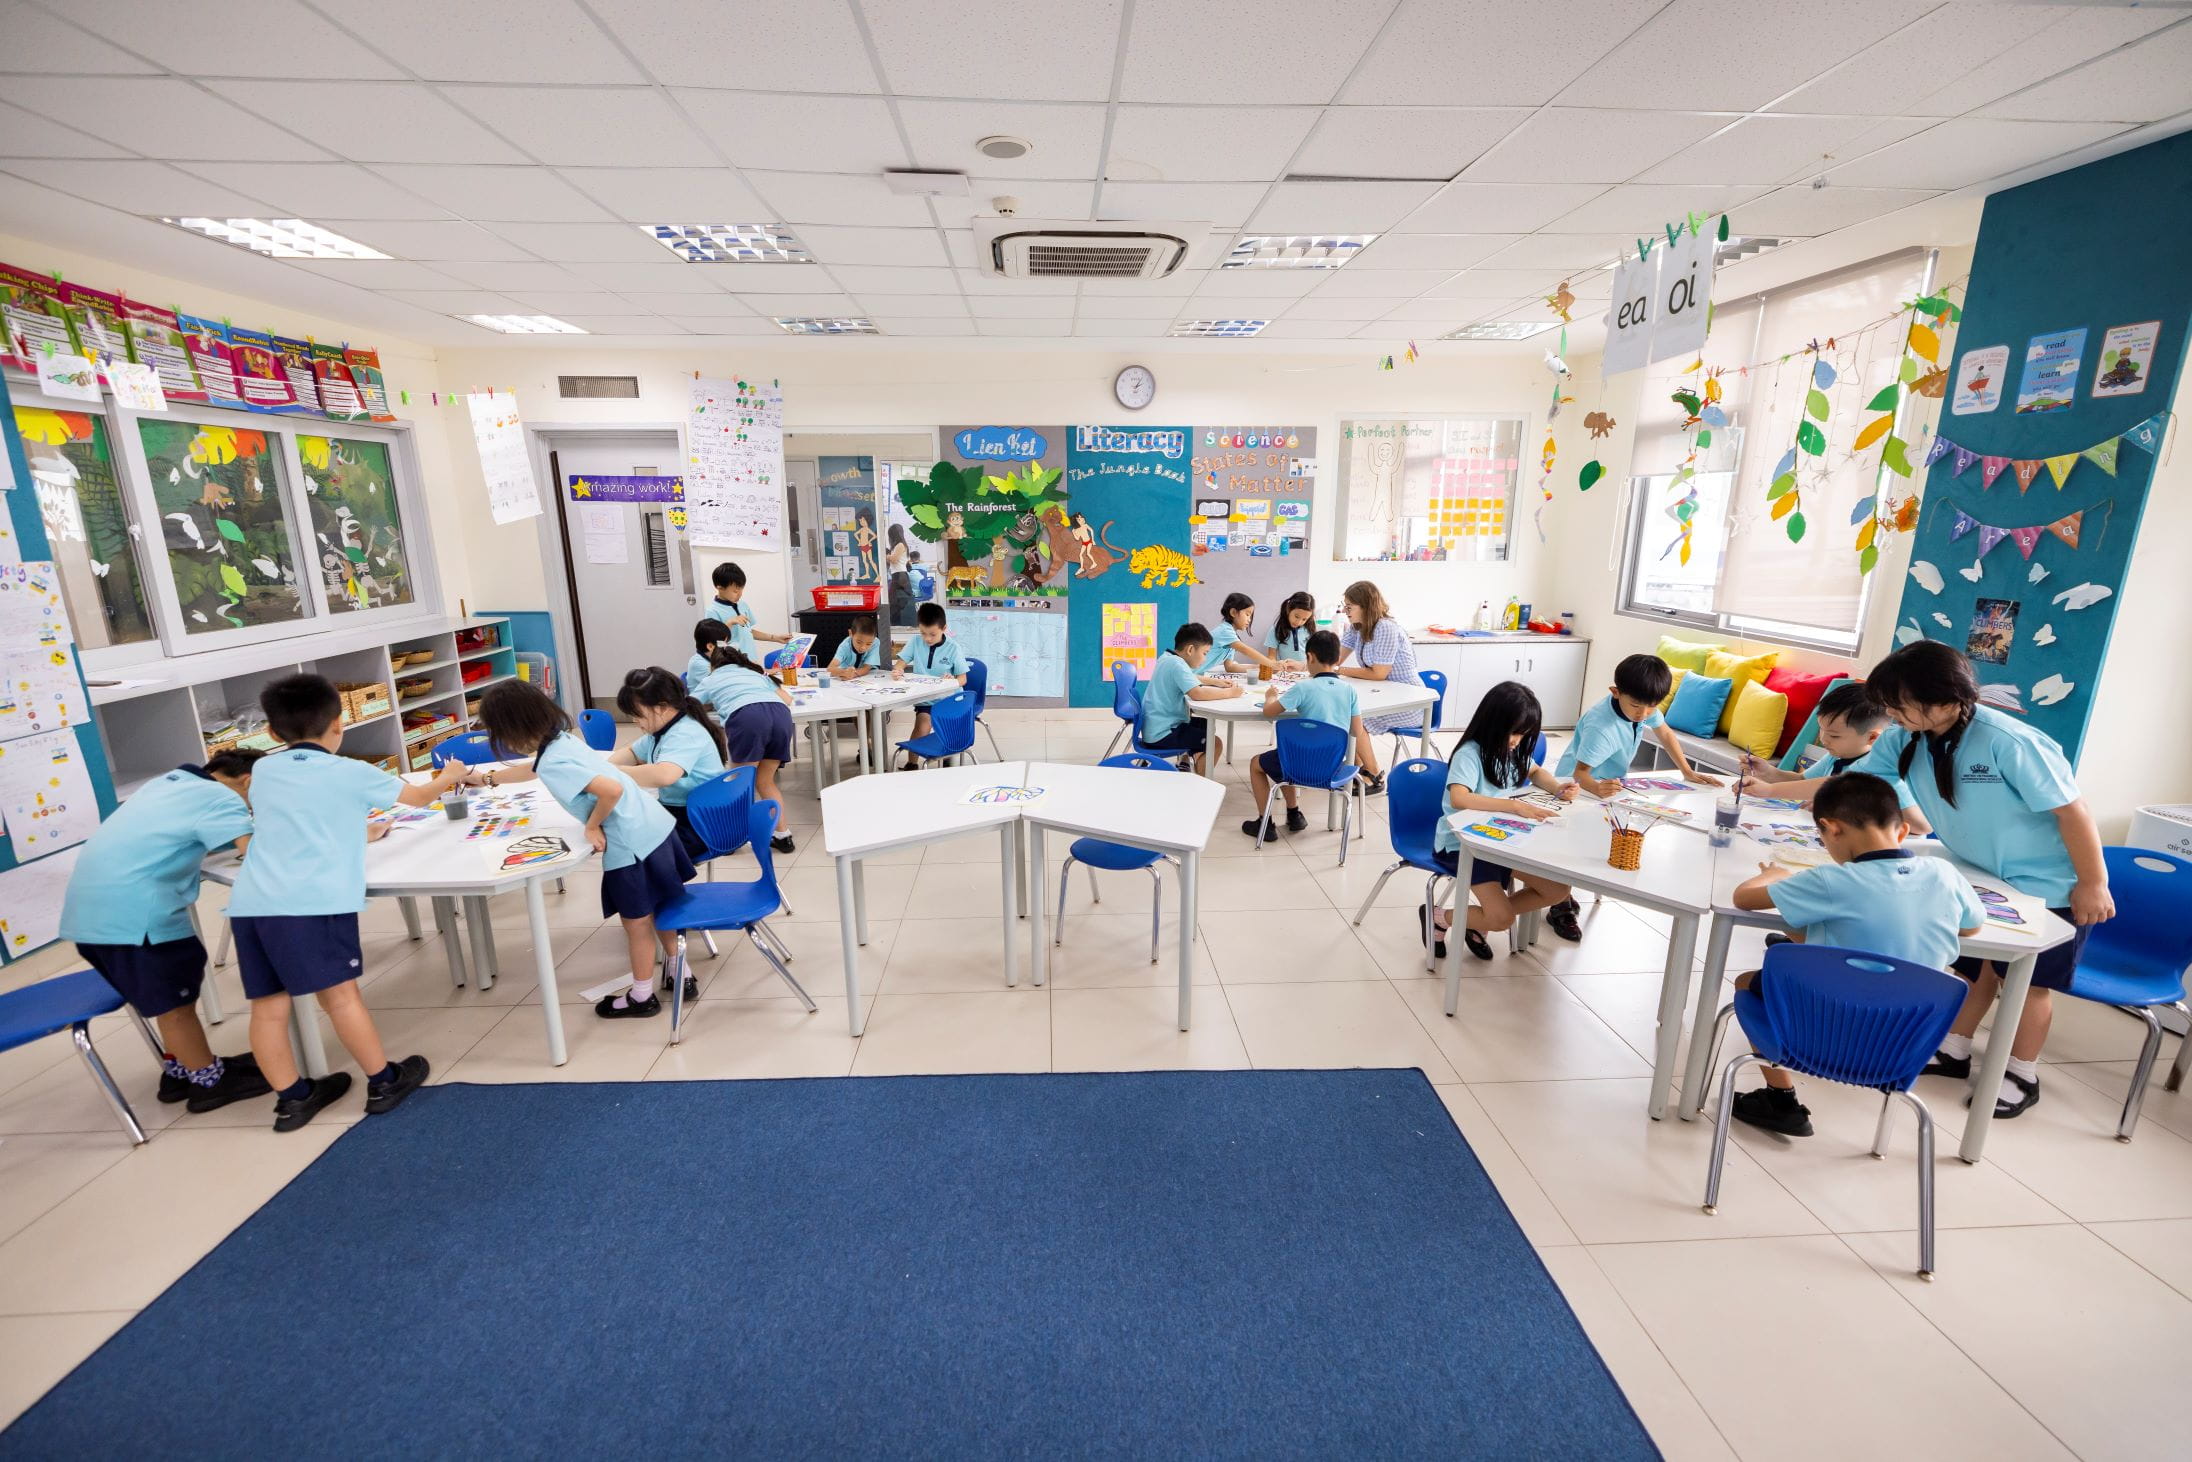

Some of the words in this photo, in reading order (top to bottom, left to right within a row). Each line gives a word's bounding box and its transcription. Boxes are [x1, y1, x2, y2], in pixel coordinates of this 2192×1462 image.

[0, 271, 30, 288] alking
[1668, 260, 1697, 315] oi
[1617, 296, 1647, 330] ea
[186, 322, 222, 337] Fan--Pick
[2046, 339, 2067, 350] read
[2038, 370, 2061, 380] learn
[1076, 425, 1185, 459] Literacy
[1205, 430, 1299, 447] Science
[1932, 428, 2152, 480] Reading
[1068, 467, 1096, 481] The
[1099, 462, 1151, 477] Jungle
[1190, 452, 1258, 476] States
[582, 481, 636, 496] Amazing
[639, 480, 671, 493] work!
[1228, 474, 1308, 494] Matter
[945, 502, 964, 513] The
[967, 502, 1017, 515] Rainforest
[1278, 504, 1299, 516] GAS
[1954, 520, 2075, 547] Area
